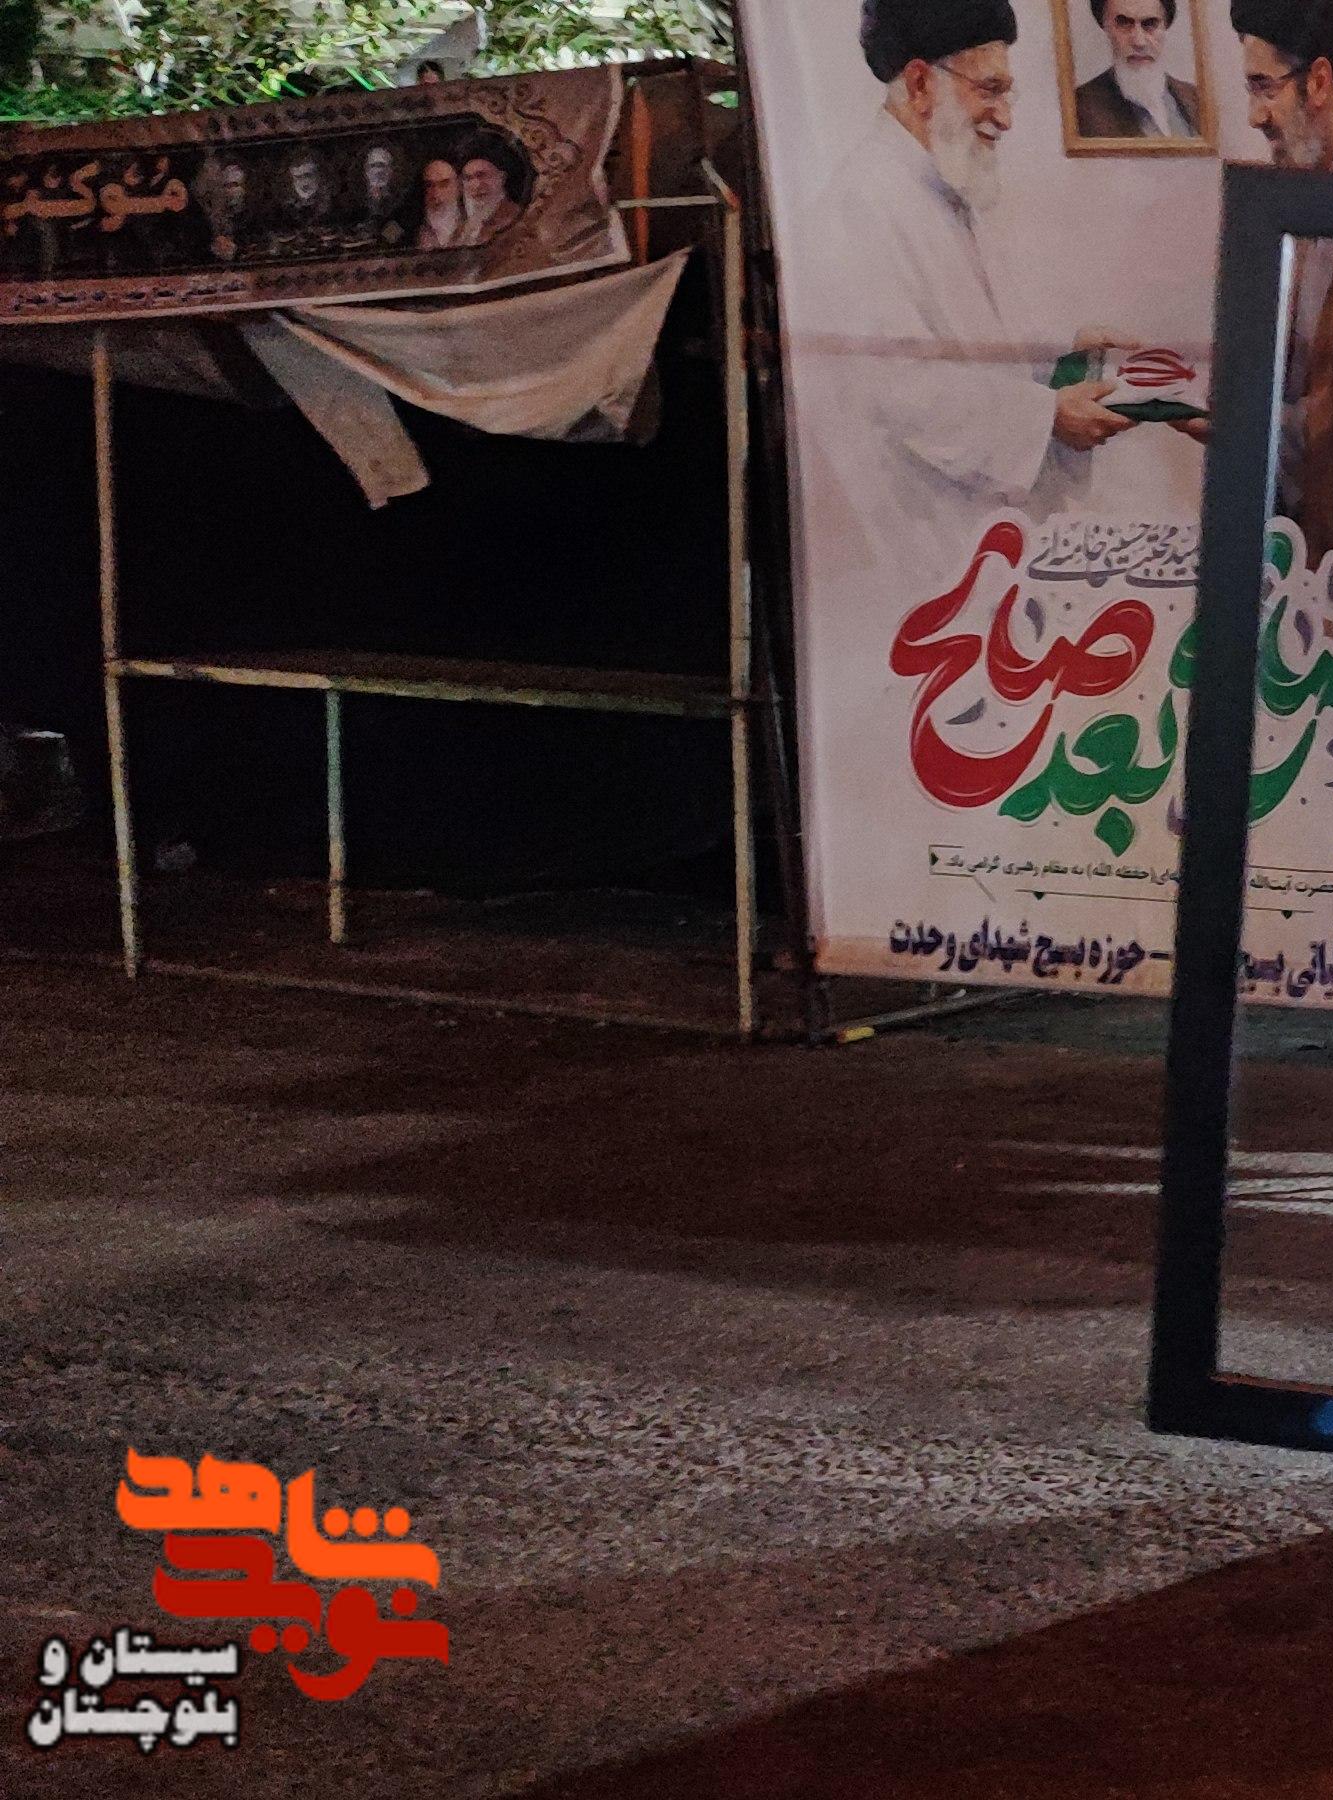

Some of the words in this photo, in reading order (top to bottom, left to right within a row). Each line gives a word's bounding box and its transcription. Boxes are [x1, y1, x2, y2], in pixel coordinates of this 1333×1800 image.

[889, 520, 1156, 808] صالح
[997, 690, 1182, 857] بعد
[1032, 934, 1086, 978] بسیج
[1088, 933, 1146, 984] حوزه
[1239, 950, 1284, 993] بسی
